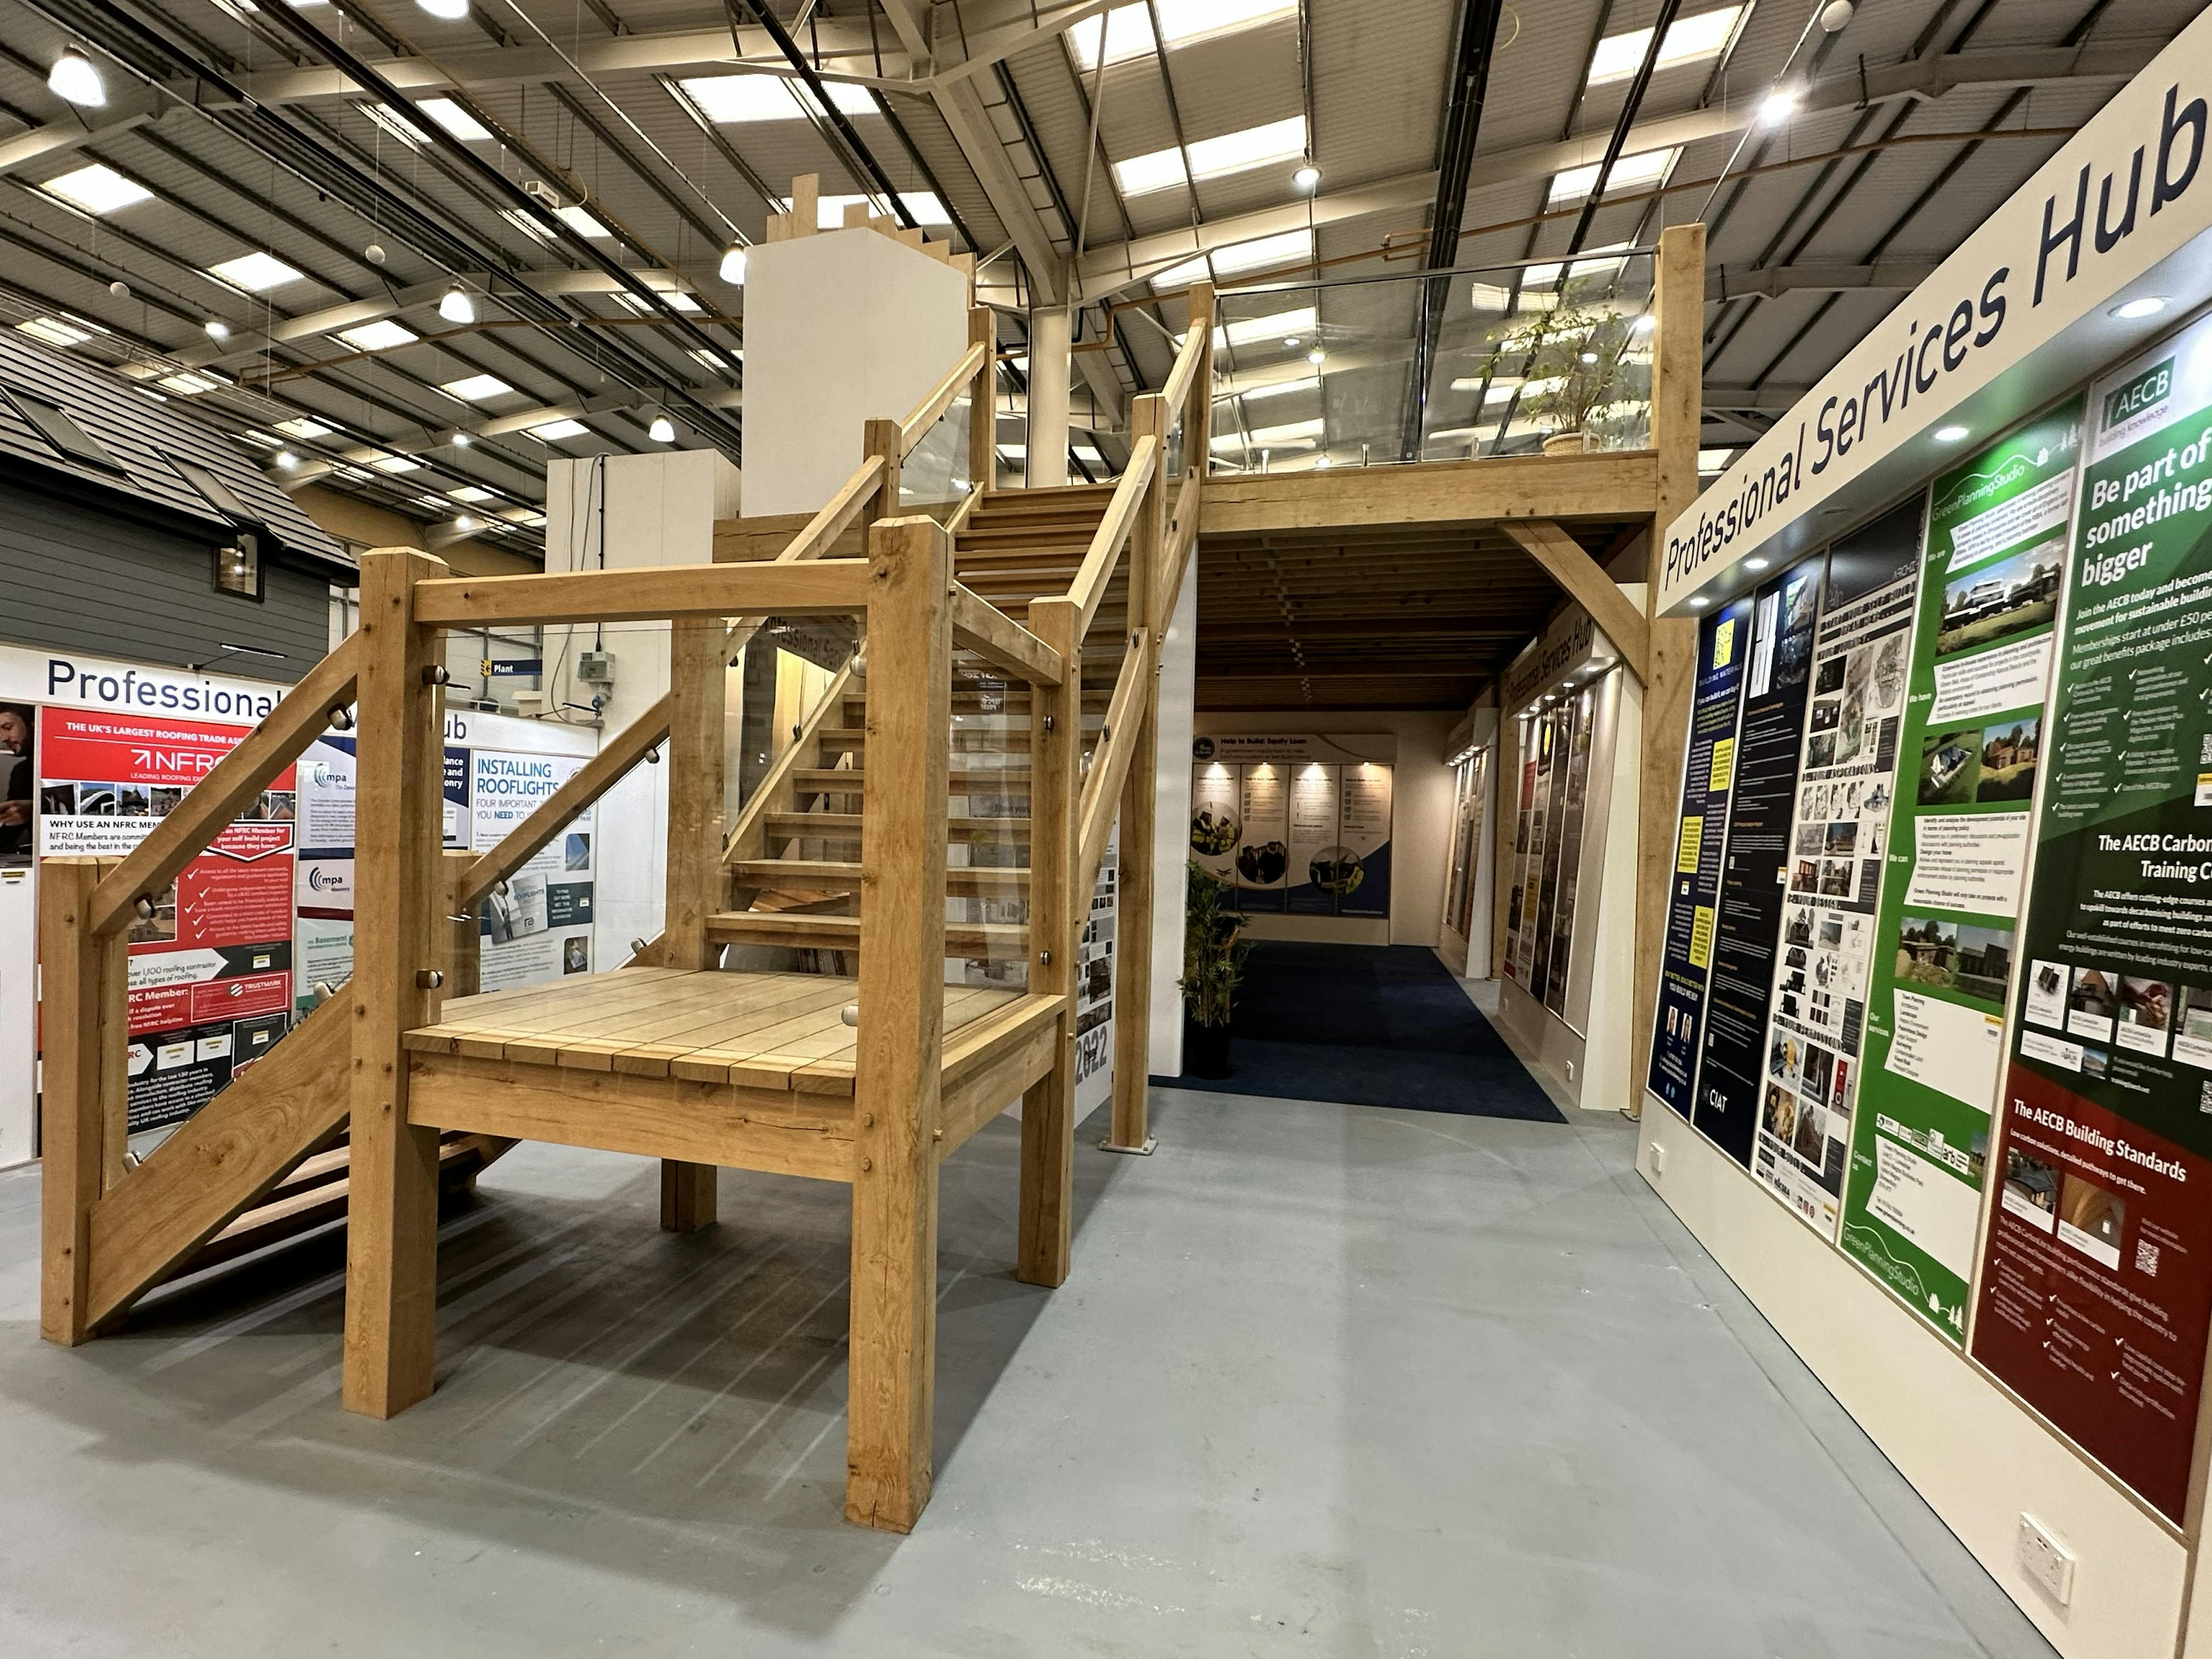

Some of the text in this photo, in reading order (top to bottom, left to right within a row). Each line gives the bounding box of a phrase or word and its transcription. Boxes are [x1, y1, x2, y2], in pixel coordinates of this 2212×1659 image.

[1664, 424, 1804, 591] Professional
[1811, 267, 2010, 475] Services
[2033, 85, 2208, 307] Hub
[2115, 370, 2169, 419] AECB
[2127, 404, 2170, 434] knowledge
[2091, 427, 2211, 510] Be part of
[2086, 476, 2212, 548] something
[2082, 540, 2153, 587] bigger
[2076, 570, 2212, 620] Join the AECB today and become
[2075, 586, 2212, 635] movement for sustainable buildin
[1573, 616, 1591, 656] Hub
[2073, 611, 2212, 654] Memberships start at under £50 pe
[2070, 640, 2170, 670] our great benefits package
[494, 664, 513, 673] Plant
[66, 722, 86, 731] THE
[88, 724, 111, 734] UK'S
[114, 726, 155, 738] LARGEST
[156, 730, 198, 742] ROOFING
[199, 735, 226, 744] TRADE
[444, 714, 466, 739] ub
[444, 756, 464, 765] ance
[477, 759, 552, 778] INSTALLING
[326, 775, 346, 783] mpa
[447, 768, 463, 776] and
[444, 780, 462, 789] onry
[477, 778, 559, 795] ROOFLIGHTS
[476, 798, 537, 808] FOUR IMPORTANT
[477, 810, 526, 819] YOU NEED TO
[65, 843, 84, 851] being
[2098, 834, 2212, 852] The AECB Carbon
[2141, 860, 2198, 882] Training
[322, 877, 342, 885] mpa
[2094, 890, 2104, 898] The
[2104, 891, 2121, 899] AECB
[2151, 923, 2158, 932] to
[2176, 927, 2192, 935] zero
[2192, 928, 2212, 938] carbo
[315, 935, 347, 944] Basement
[143, 967, 161, 975] 1,100
[148, 977, 165, 985] types
[245, 980, 281, 989] TRUSTMARK
[128, 989, 188, 1003] RC Member:
[128, 1049, 141, 1059] RC
[1076, 1026, 1107, 1086] 2022
[1709, 1089, 1728, 1113] CIAT
[2014, 1098, 2187, 1182] The AECB Building Standards
[1943, 1148, 1955, 1164] arb
[2116, 1176, 2127, 1187] get
[1843, 1228, 1919, 1296] GreenPlanningStudio
